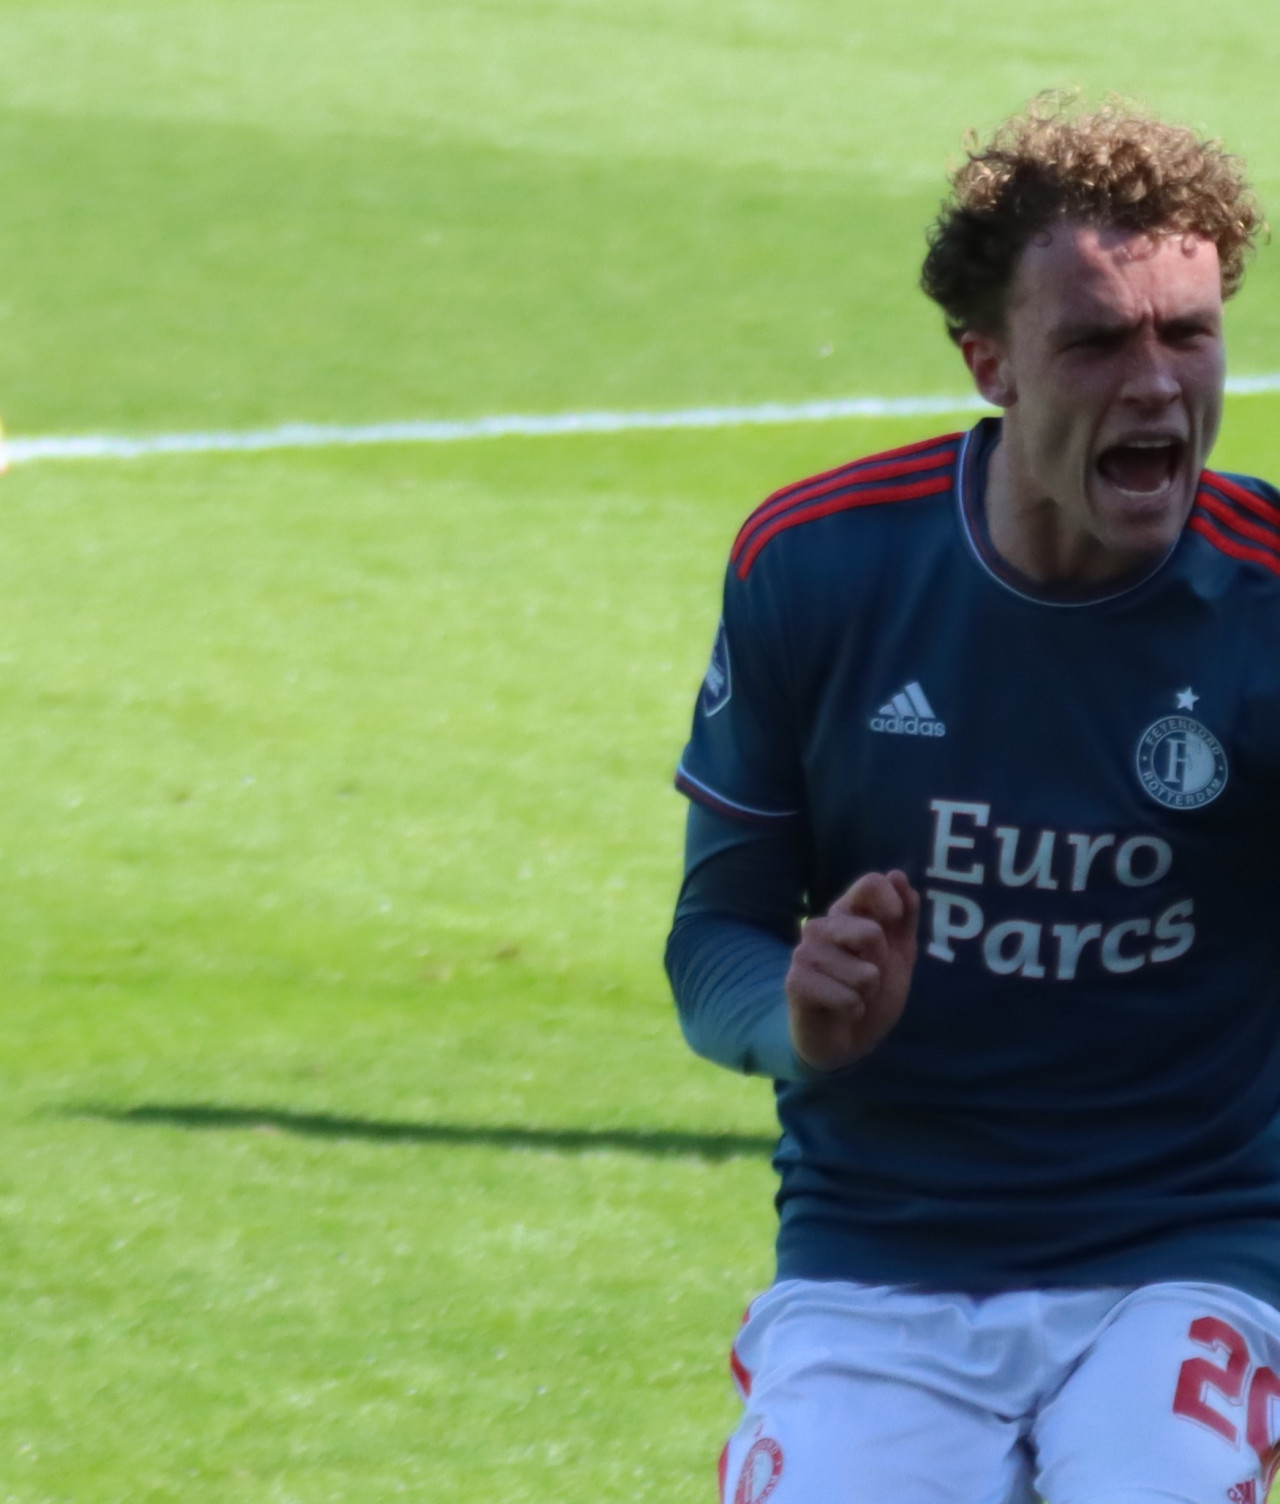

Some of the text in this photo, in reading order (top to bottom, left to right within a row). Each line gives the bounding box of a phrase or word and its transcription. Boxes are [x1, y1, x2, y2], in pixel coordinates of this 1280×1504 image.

[869, 715, 946, 738] adidas
[925, 798, 1174, 893] Euro
[925, 888, 1197, 981] Parcs
